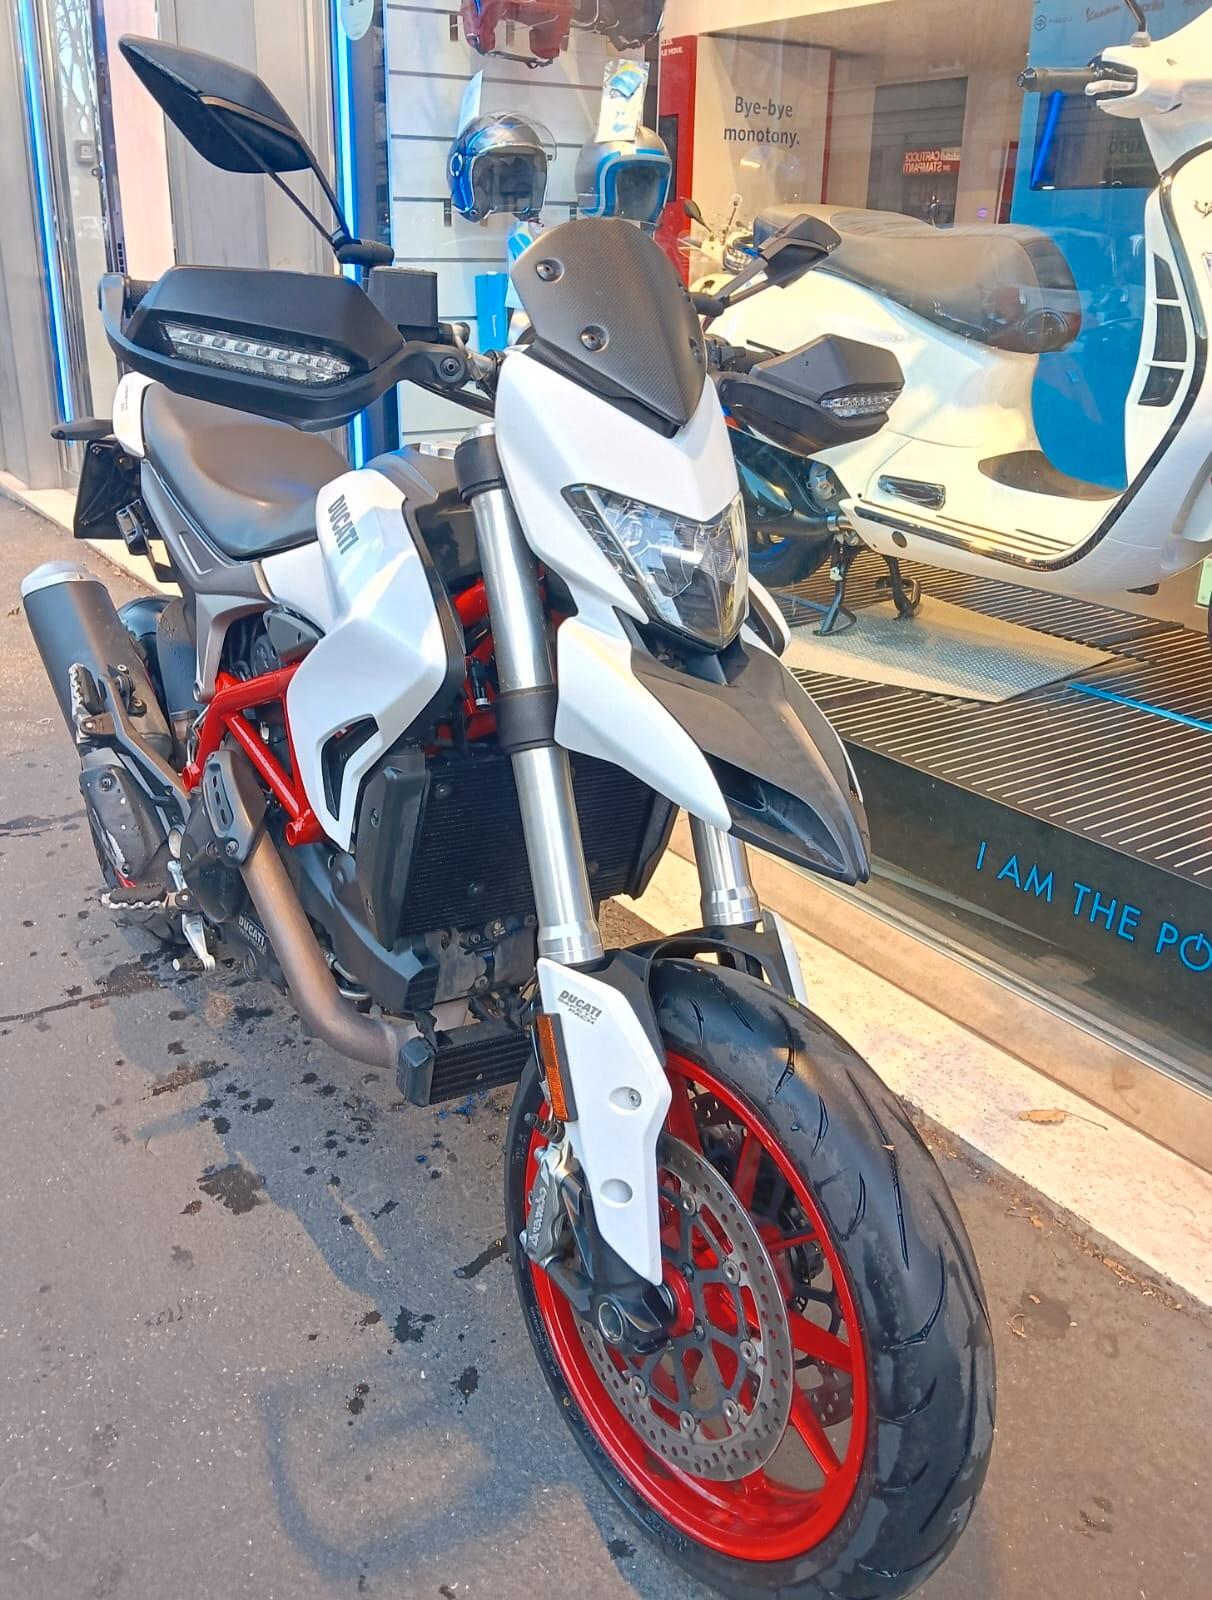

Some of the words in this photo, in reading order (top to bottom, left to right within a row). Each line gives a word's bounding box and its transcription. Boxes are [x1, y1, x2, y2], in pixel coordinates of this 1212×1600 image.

[735, 96, 793, 120] Bye-bye
[724, 128, 800, 149] monotony.
[328, 494, 359, 556] DUCATI
[976, 841, 987, 871] I
[996, 854, 1055, 903] AM
[1073, 881, 1142, 943] THE
[239, 915, 266, 946] DUCATI
[560, 990, 603, 1018] DUCATI
